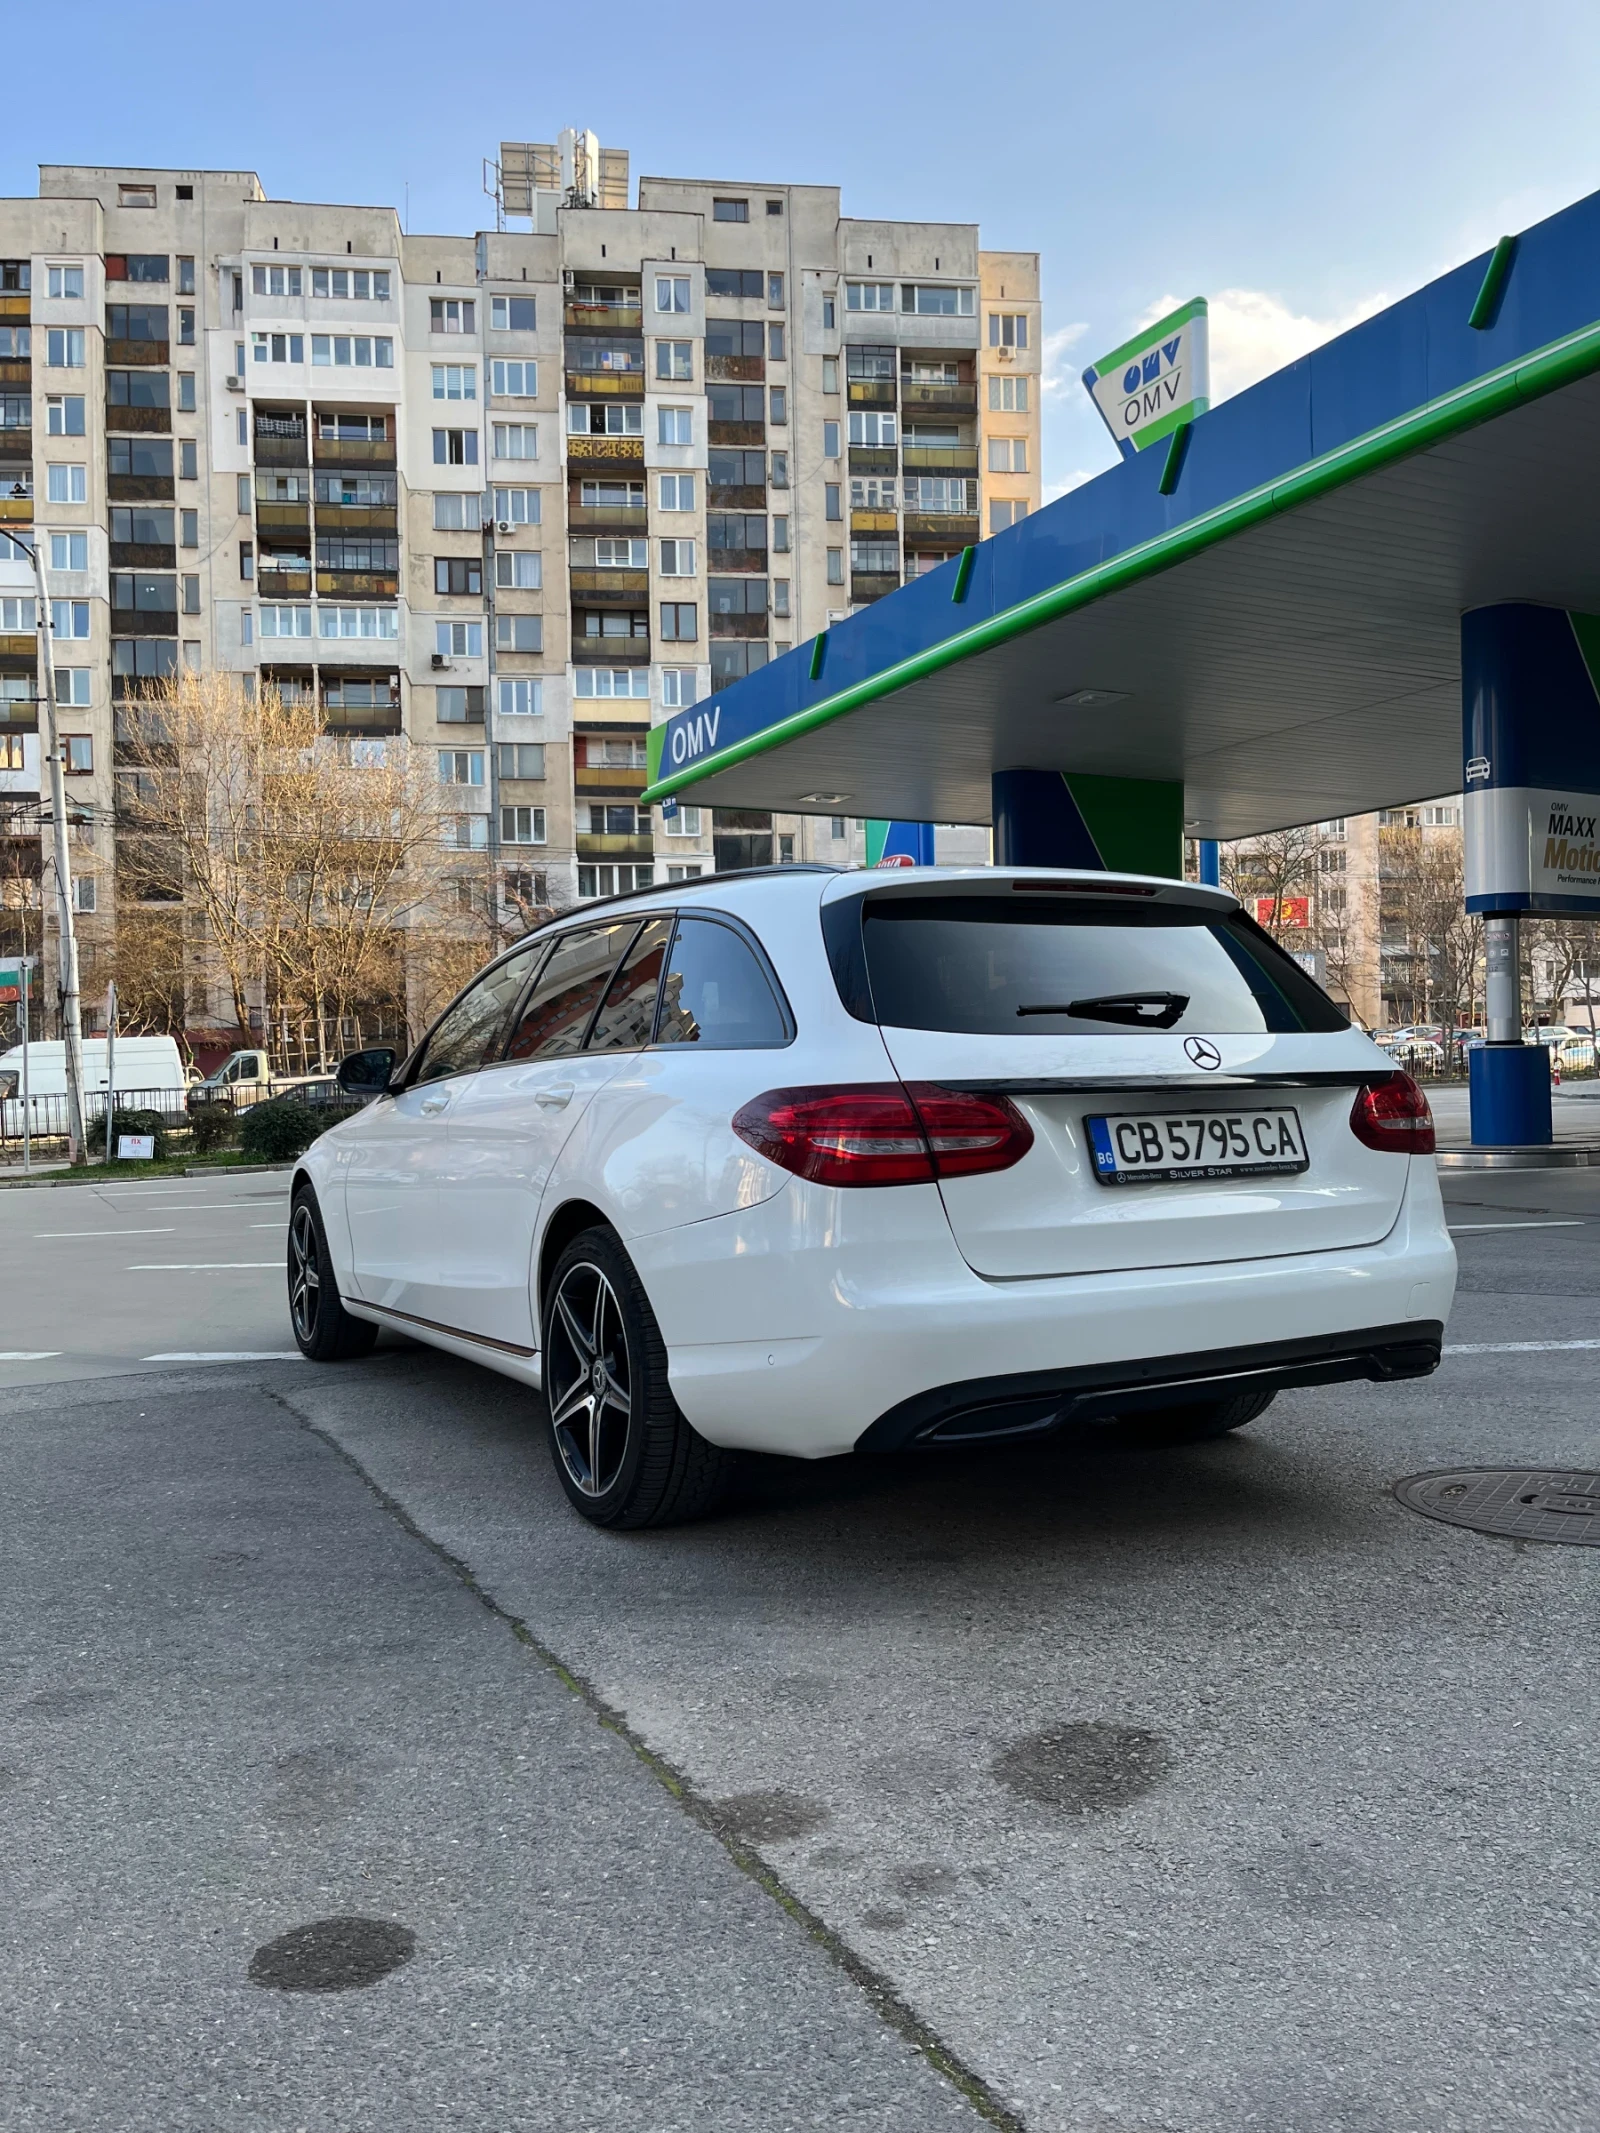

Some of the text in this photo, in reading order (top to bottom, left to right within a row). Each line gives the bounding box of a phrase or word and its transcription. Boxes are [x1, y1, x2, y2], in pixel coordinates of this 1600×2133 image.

[1124, 372, 1181, 426] OMV
[672, 706, 720, 765] OMV
[1551, 802, 1569, 812] OMV
[1548, 813, 1597, 839] MAXX
[1557, 873, 1597, 885] Performance
[1098, 1152, 1114, 1164] BG
[1169, 1169, 1205, 1179] SILVER
[1207, 1167, 1233, 1176] STAR
